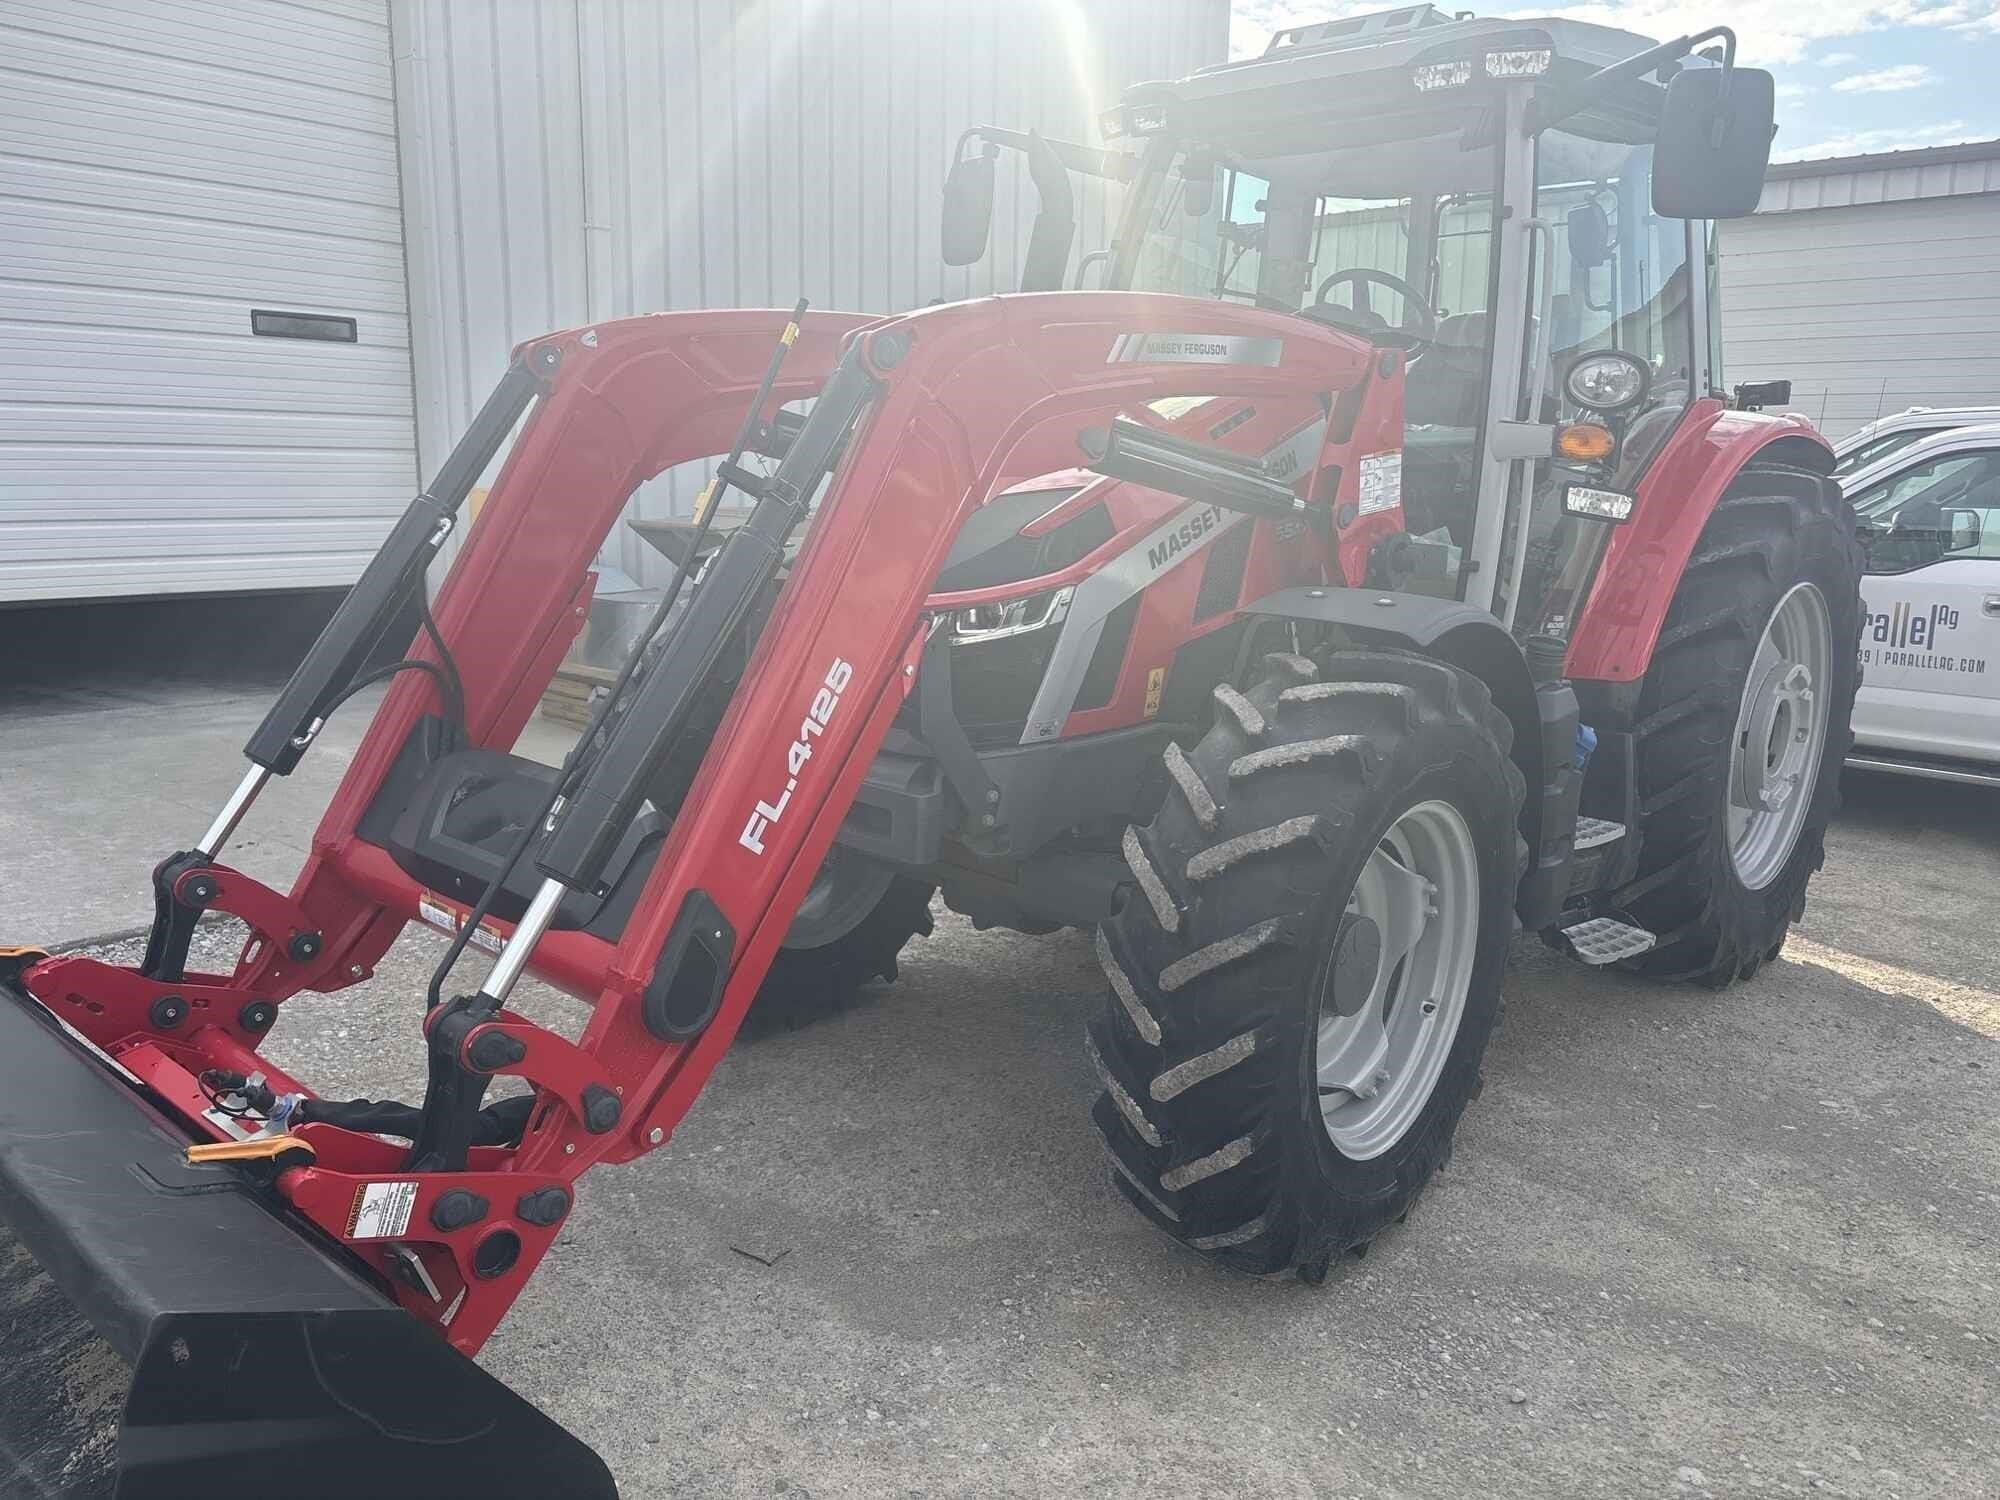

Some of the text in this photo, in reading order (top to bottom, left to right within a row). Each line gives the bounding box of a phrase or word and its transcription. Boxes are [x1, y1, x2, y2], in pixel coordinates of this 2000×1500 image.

[1184, 343, 1227, 355] FERGUSON
[1148, 505, 1221, 570] MASSEY
[1884, 651, 1985, 673] PARALLELAG.COM
[738, 656, 854, 856] FL.4125
